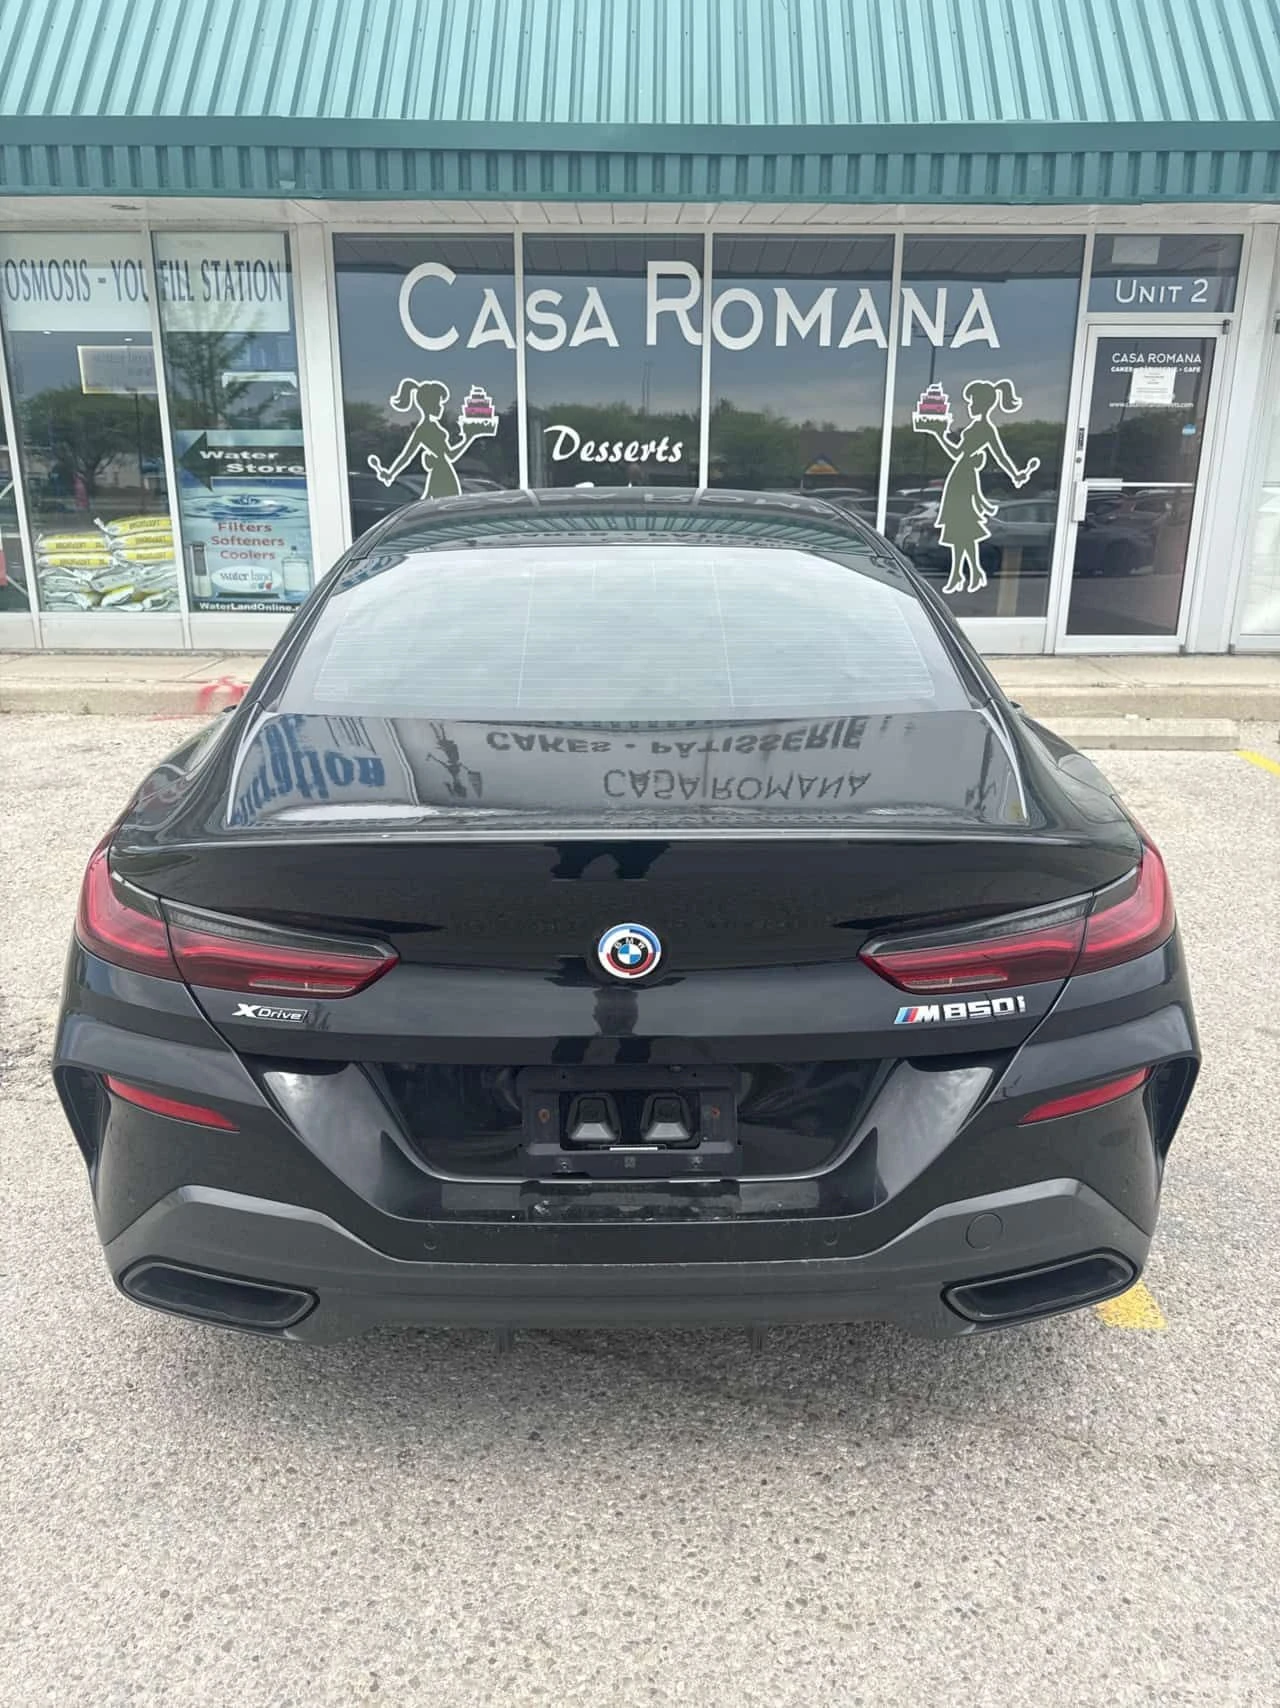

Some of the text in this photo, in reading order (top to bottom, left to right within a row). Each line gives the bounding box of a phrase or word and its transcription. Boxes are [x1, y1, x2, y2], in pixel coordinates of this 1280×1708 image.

[4, 258, 91, 302] OSMOSIS
[159, 259, 195, 302] FILL
[201, 258, 283, 302] STATION
[1190, 278, 1209, 303] 2
[1111, 352, 1202, 364] CASA ROMANA
[543, 424, 684, 463] Desserts
[199, 450, 280, 460] Water
[226, 463, 308, 475] Store
[217, 521, 273, 533] Filters
[211, 535, 285, 547] Softeners
[220, 549, 276, 560] Coolers
